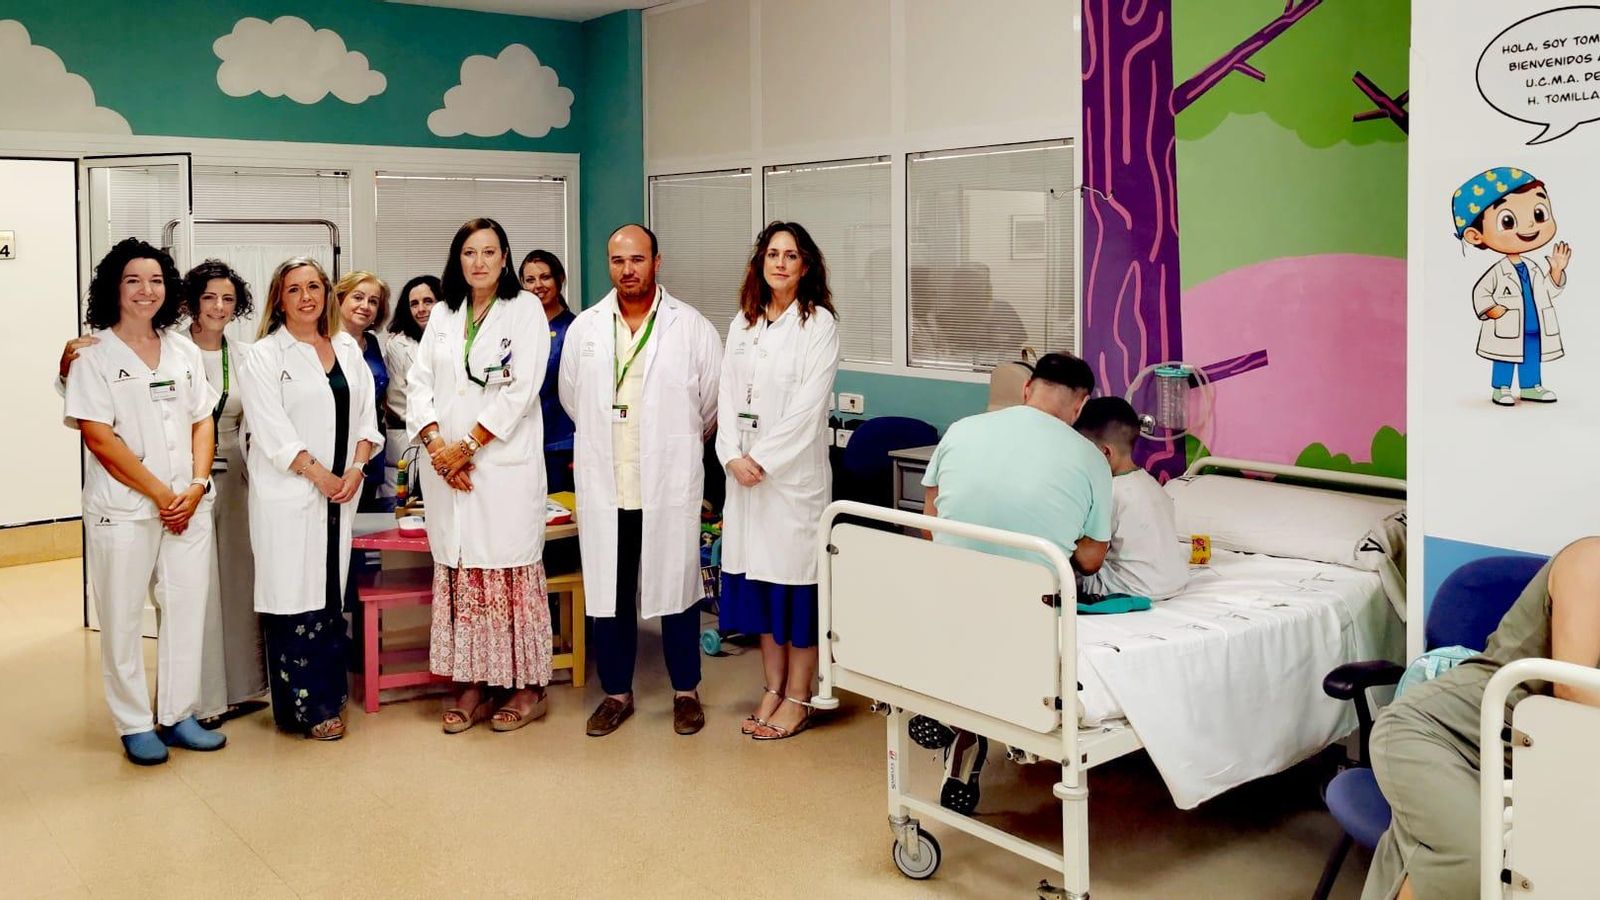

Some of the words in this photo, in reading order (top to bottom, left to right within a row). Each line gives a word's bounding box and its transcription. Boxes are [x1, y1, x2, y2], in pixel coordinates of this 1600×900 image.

[1502, 42, 1538, 54] HOLA,
[1542, 38, 1568, 49] SOY
[1509, 53, 1592, 71] BIENVENIDOS
[1526, 74, 1579, 88] U.C.M.A.
[1528, 97, 1540, 105] H.
